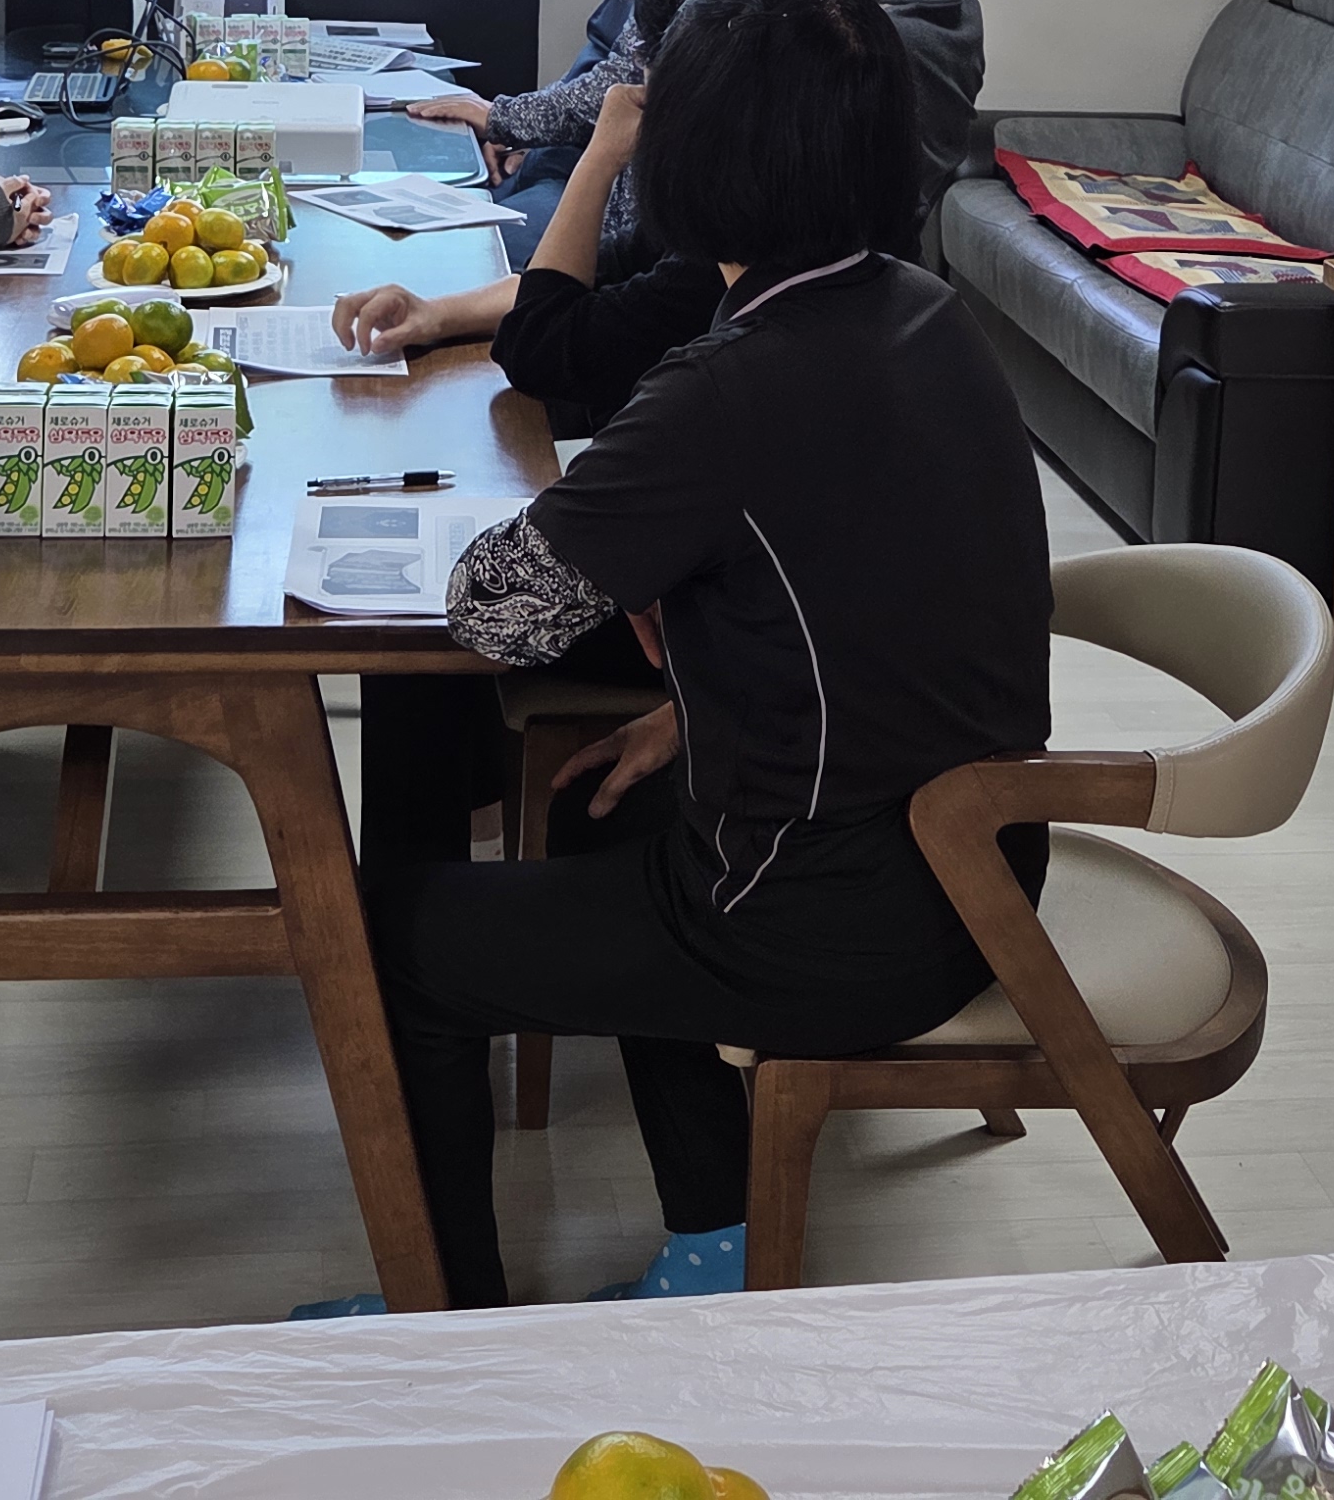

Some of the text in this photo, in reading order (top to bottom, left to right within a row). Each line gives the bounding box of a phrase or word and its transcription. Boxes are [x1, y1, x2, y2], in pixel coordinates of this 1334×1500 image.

[49, 416, 89, 426] 제로슈거
[111, 417, 151, 426] 제로슈거
[179, 418, 218, 428] 제로슈거
[48, 428, 104, 444] 삼육두유
[111, 428, 166, 444] 삼육두유
[178, 429, 233, 445] 삼육두유
